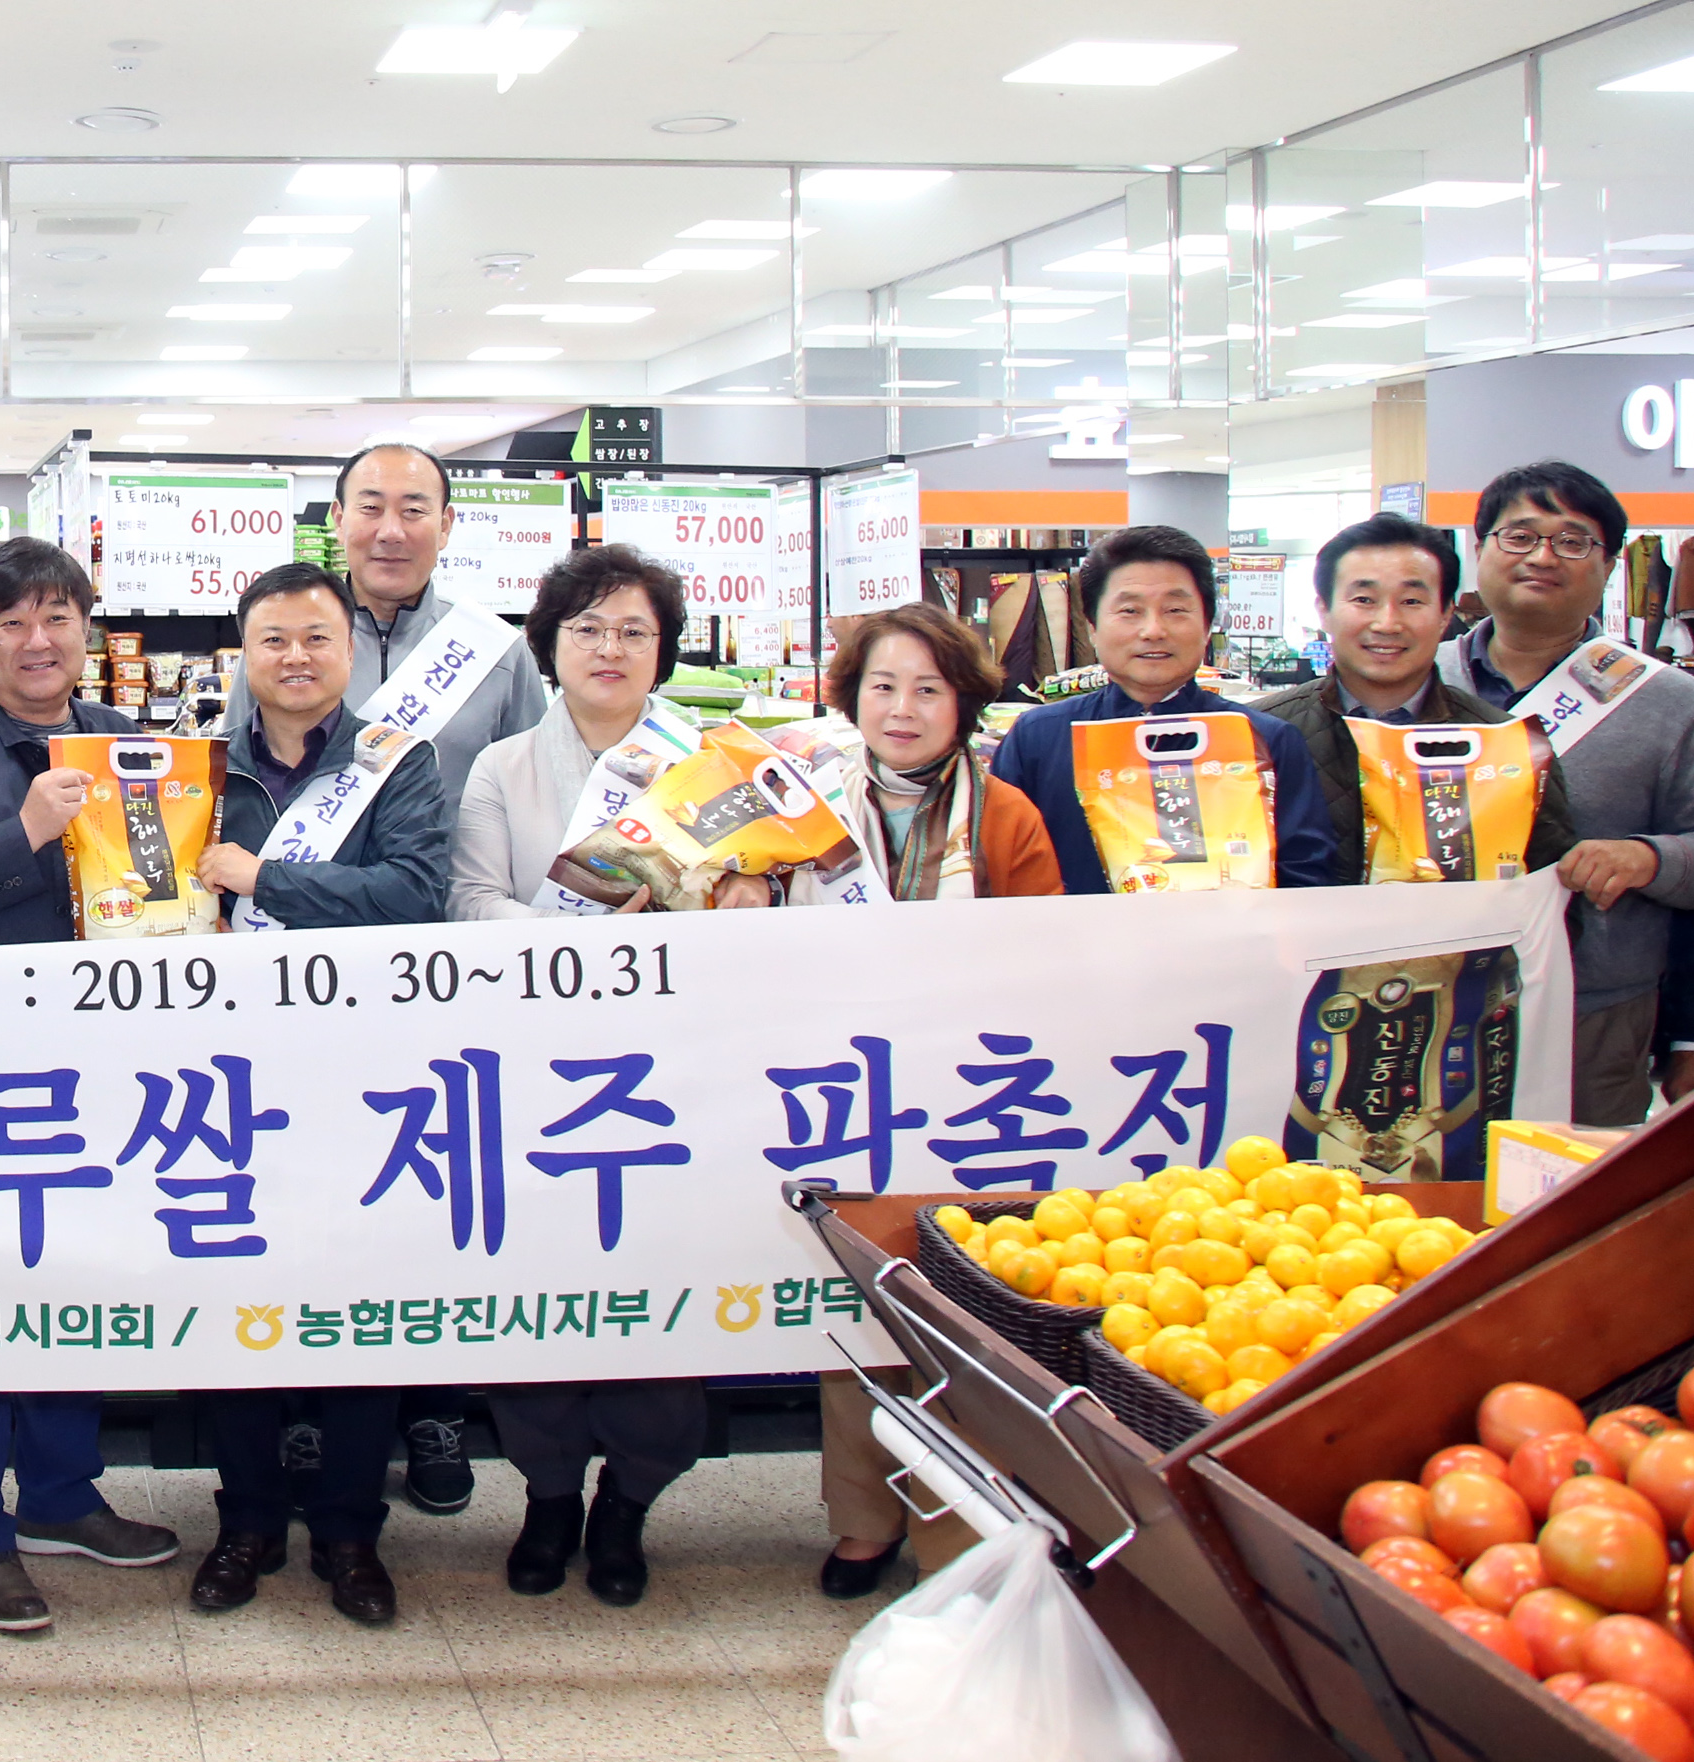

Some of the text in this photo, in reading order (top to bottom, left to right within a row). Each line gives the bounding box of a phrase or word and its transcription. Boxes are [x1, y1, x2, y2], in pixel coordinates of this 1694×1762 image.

[594, 418, 650, 432] 고추장
[470, 511, 499, 524] 20kg
[652, 499, 680, 513] 신동진
[683, 500, 707, 514] 20kg
[191, 509, 283, 536] 61,000
[675, 515, 764, 547] 57,000
[858, 515, 909, 544] 65,000
[497, 531, 552, 544] 79,000원
[453, 557, 482, 570] 20kg
[859, 575, 910, 602] 59,500
[1154, 777, 1190, 790] 당진
[1424, 785, 1461, 798] 당진
[125, 801, 156, 816] 당진
[314, 771, 360, 825] 당진
[1157, 791, 1191, 849] 해나루
[1427, 801, 1462, 871] 해나루
[128, 817, 163, 883] 해나루
[97, 900, 135, 919] 햅쌀
[75, 960, 235, 1010] 2019.
[278, 955, 356, 1006] 10.
[392, 943, 677, 1003] 30~10.31
[1327, 1010, 1349, 1023] 당진
[1361, 1020, 1405, 1116] 신동진
[361, 1049, 690, 1255] 제주
[299, 1291, 649, 1347] 농협당진시지부
[772, 1277, 876, 1326] 합덕
